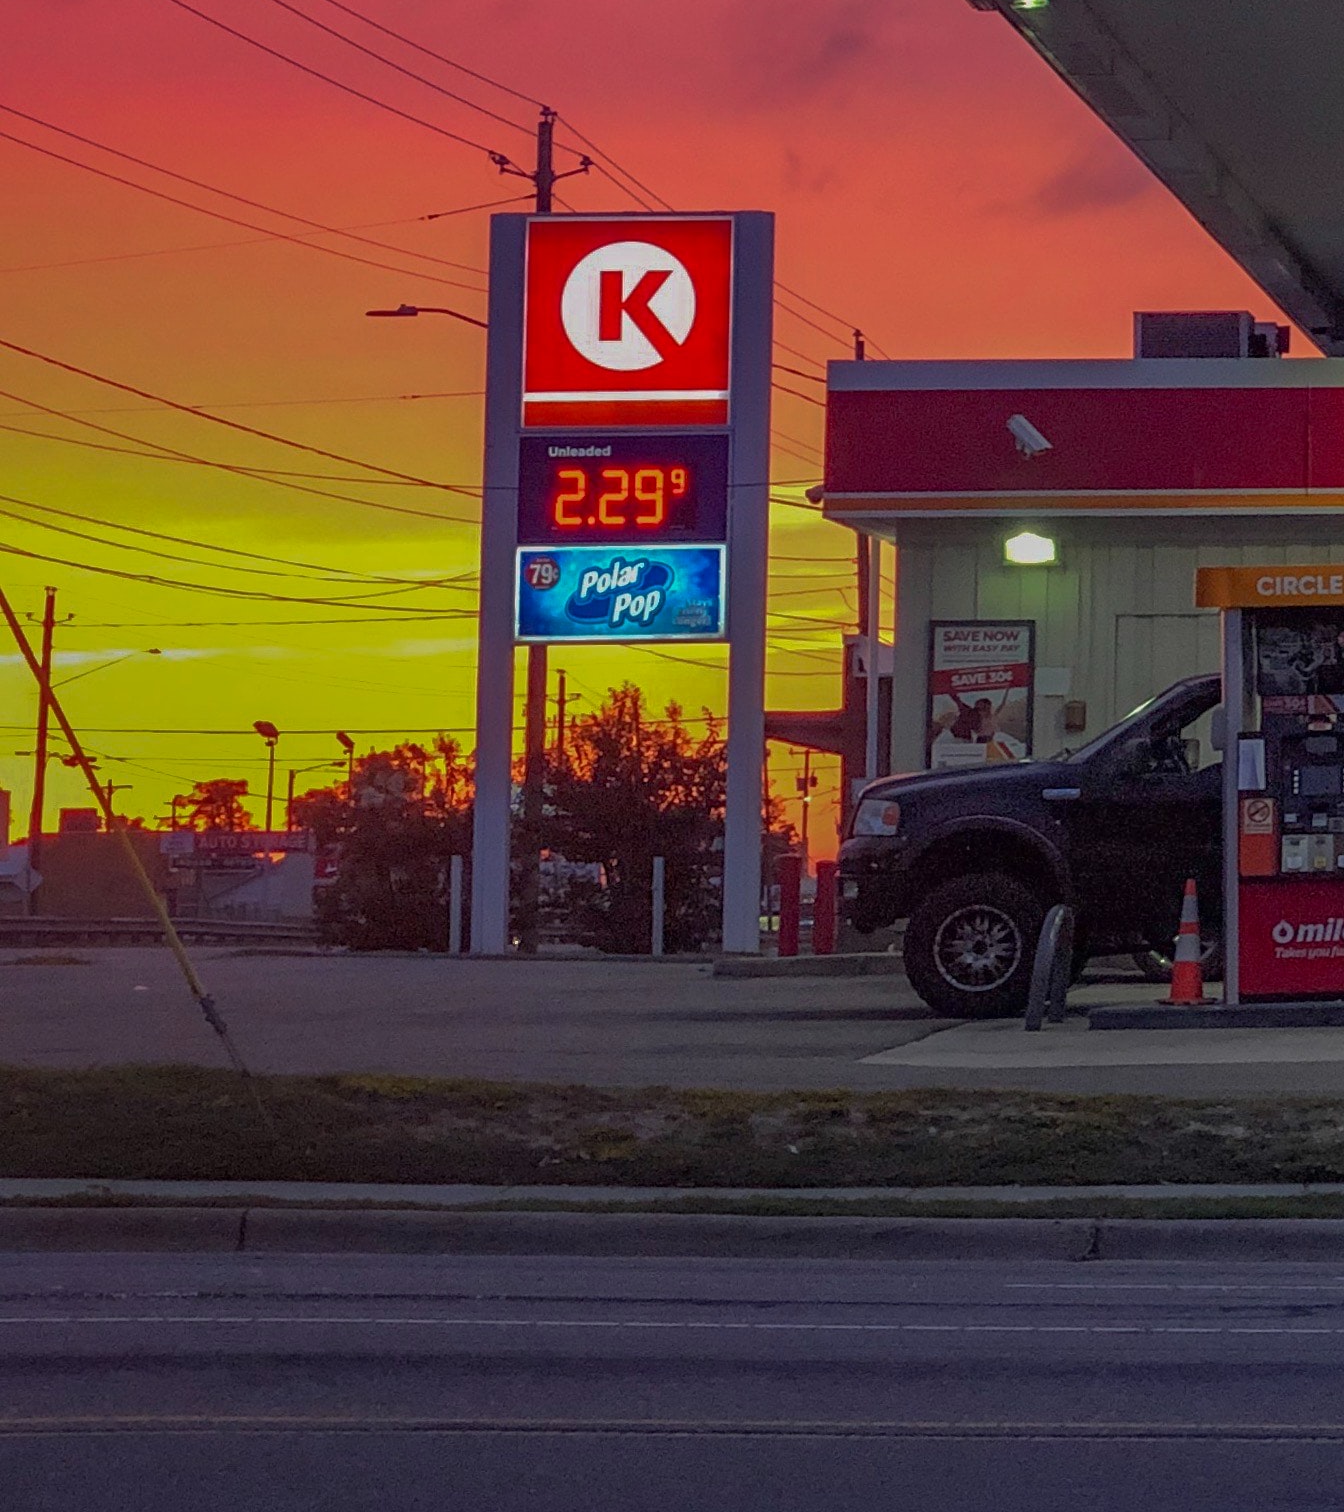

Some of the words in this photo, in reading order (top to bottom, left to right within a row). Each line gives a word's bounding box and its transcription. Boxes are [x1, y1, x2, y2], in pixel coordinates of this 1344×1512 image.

[599, 270, 683, 361] K
[548, 445, 611, 458] Unleaded
[580, 561, 645, 599] Polar
[1256, 575, 1343, 596] CIRCLE
[612, 590, 661, 623] Pop
[943, 630, 980, 642] SAVE
[983, 630, 1020, 642] NOW
[943, 644, 970, 652] WITH
[972, 644, 999, 652] EASY
[1000, 644, 1020, 652] PAY
[950, 672, 987, 687] SAVE
[198, 835, 237, 849] AUTO
[1274, 947, 1307, 959] Takes
[1307, 947, 1331, 960] you
